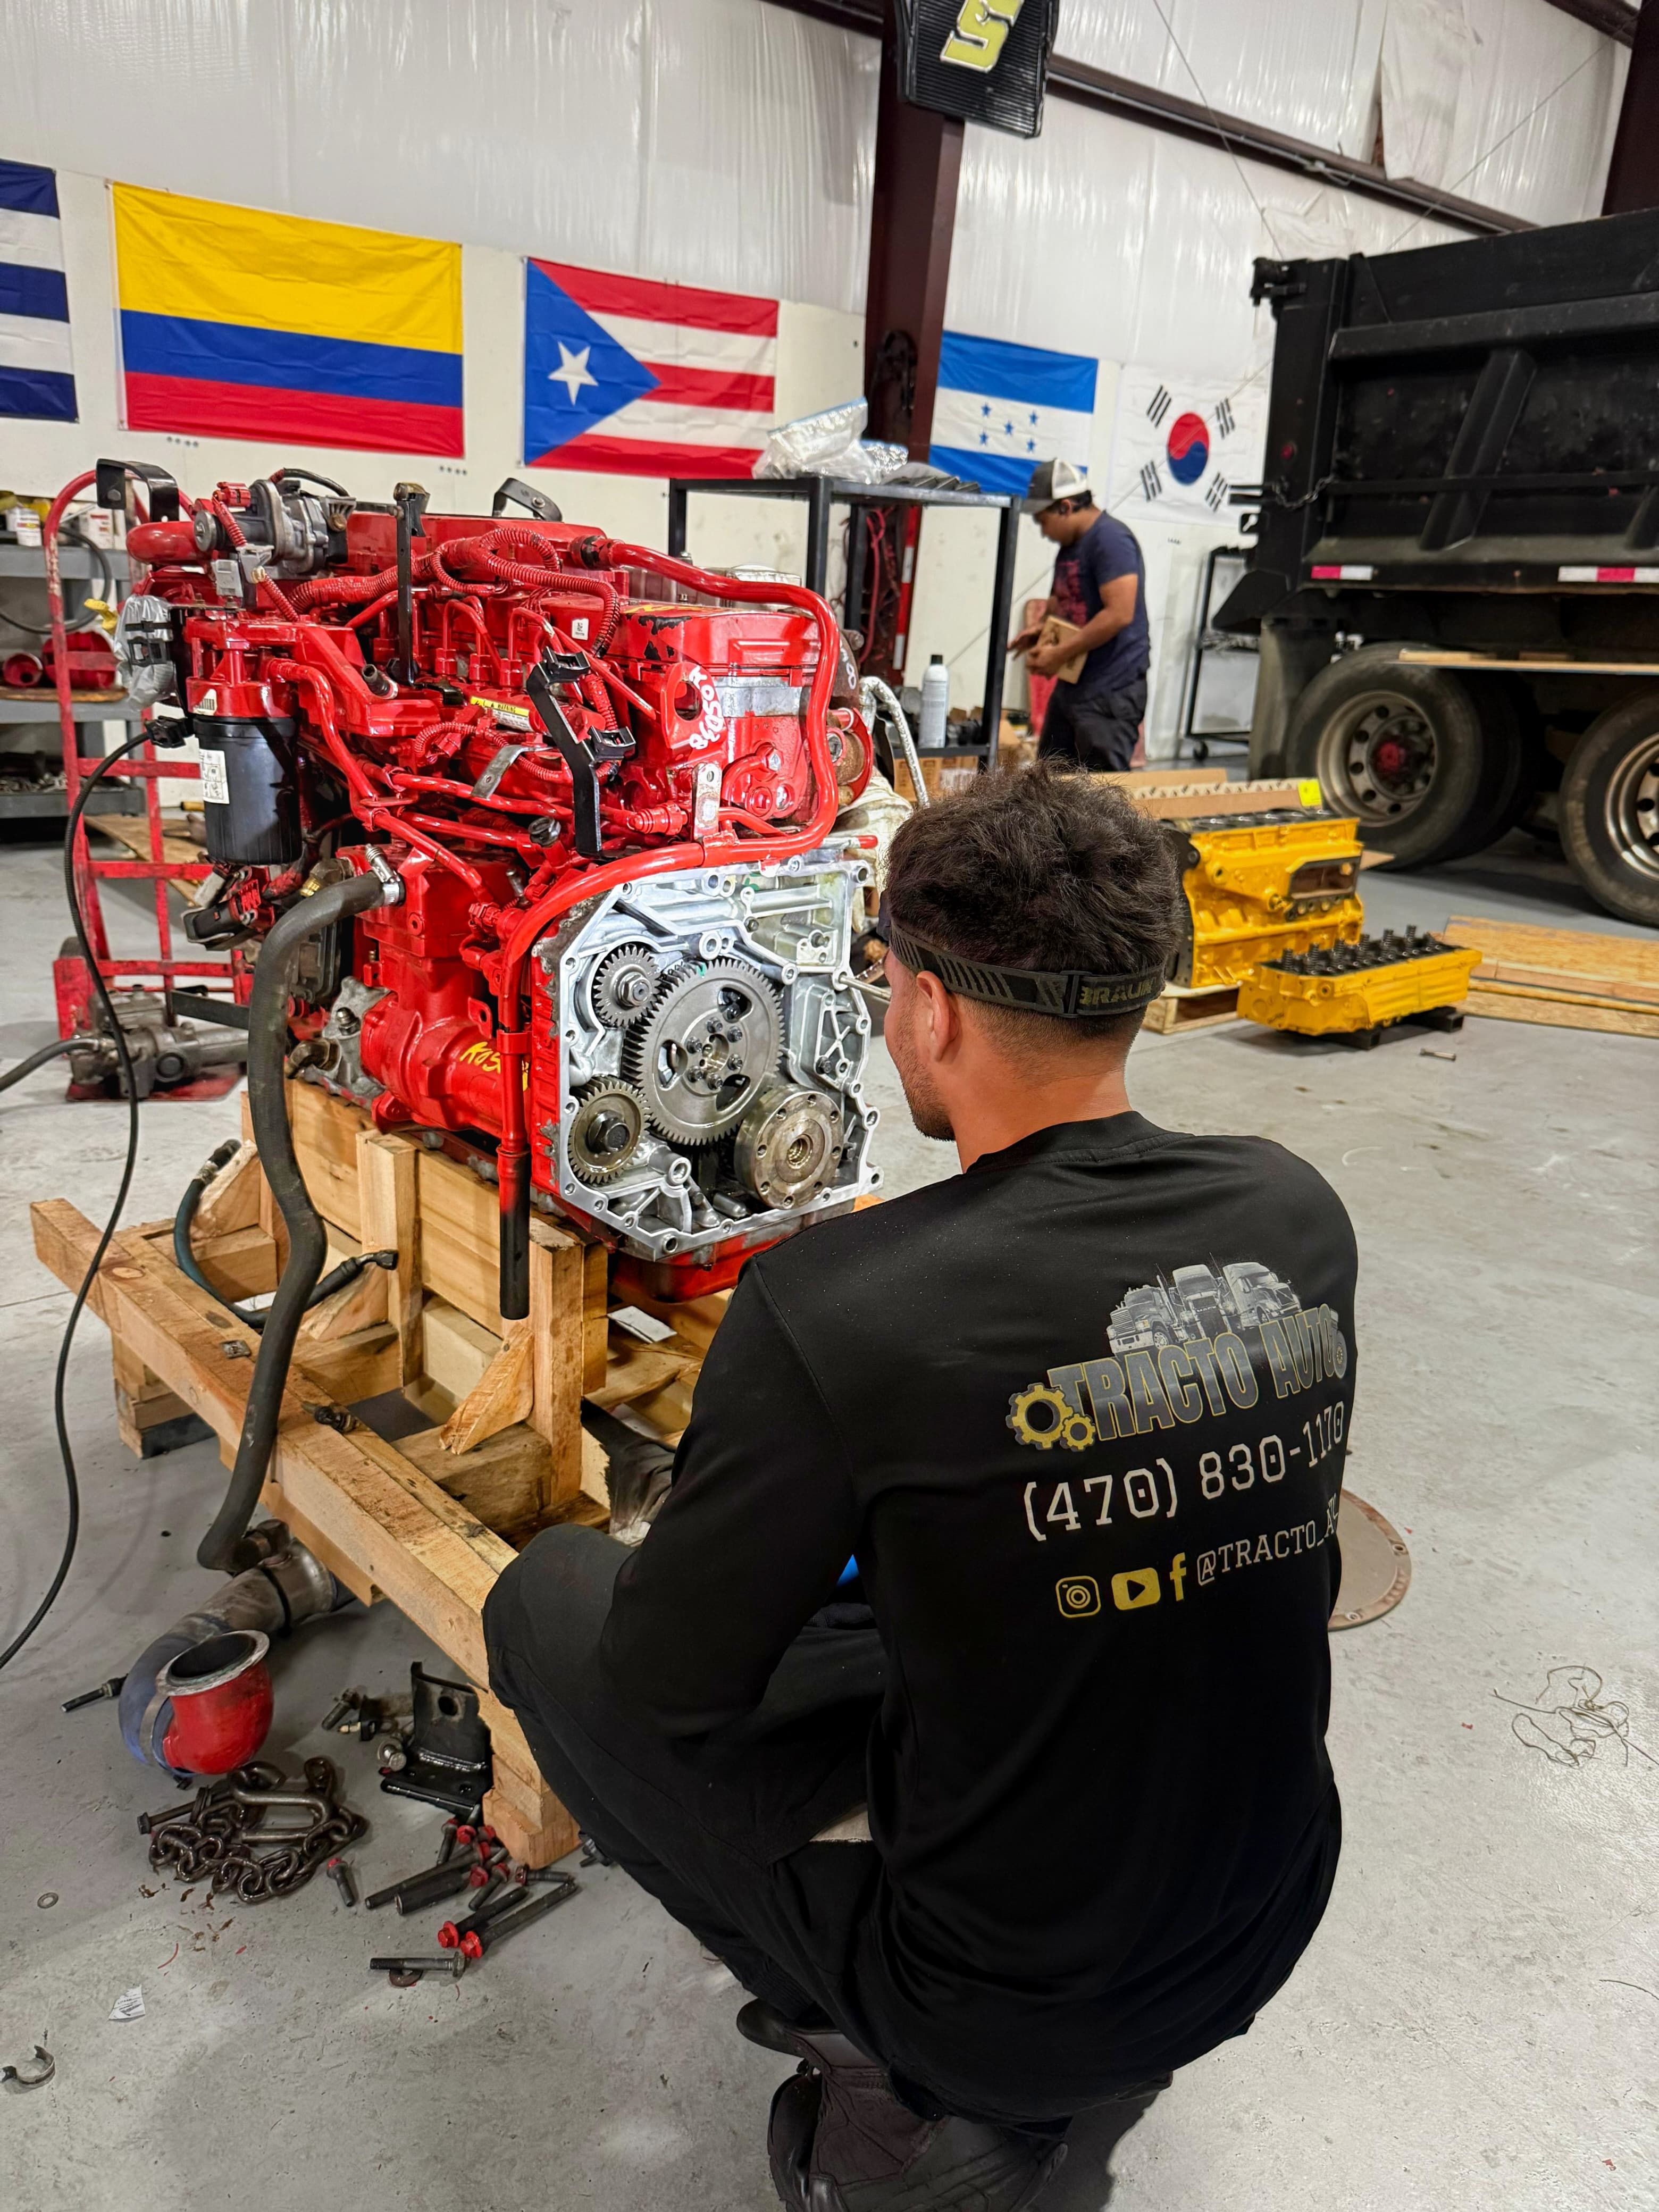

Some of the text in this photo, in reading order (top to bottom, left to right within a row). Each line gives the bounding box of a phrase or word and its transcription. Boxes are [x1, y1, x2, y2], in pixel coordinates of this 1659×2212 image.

[1047, 1332, 1258, 1442] TRACTO
[1024, 1401, 1344, 1541] (470) 830-1170
